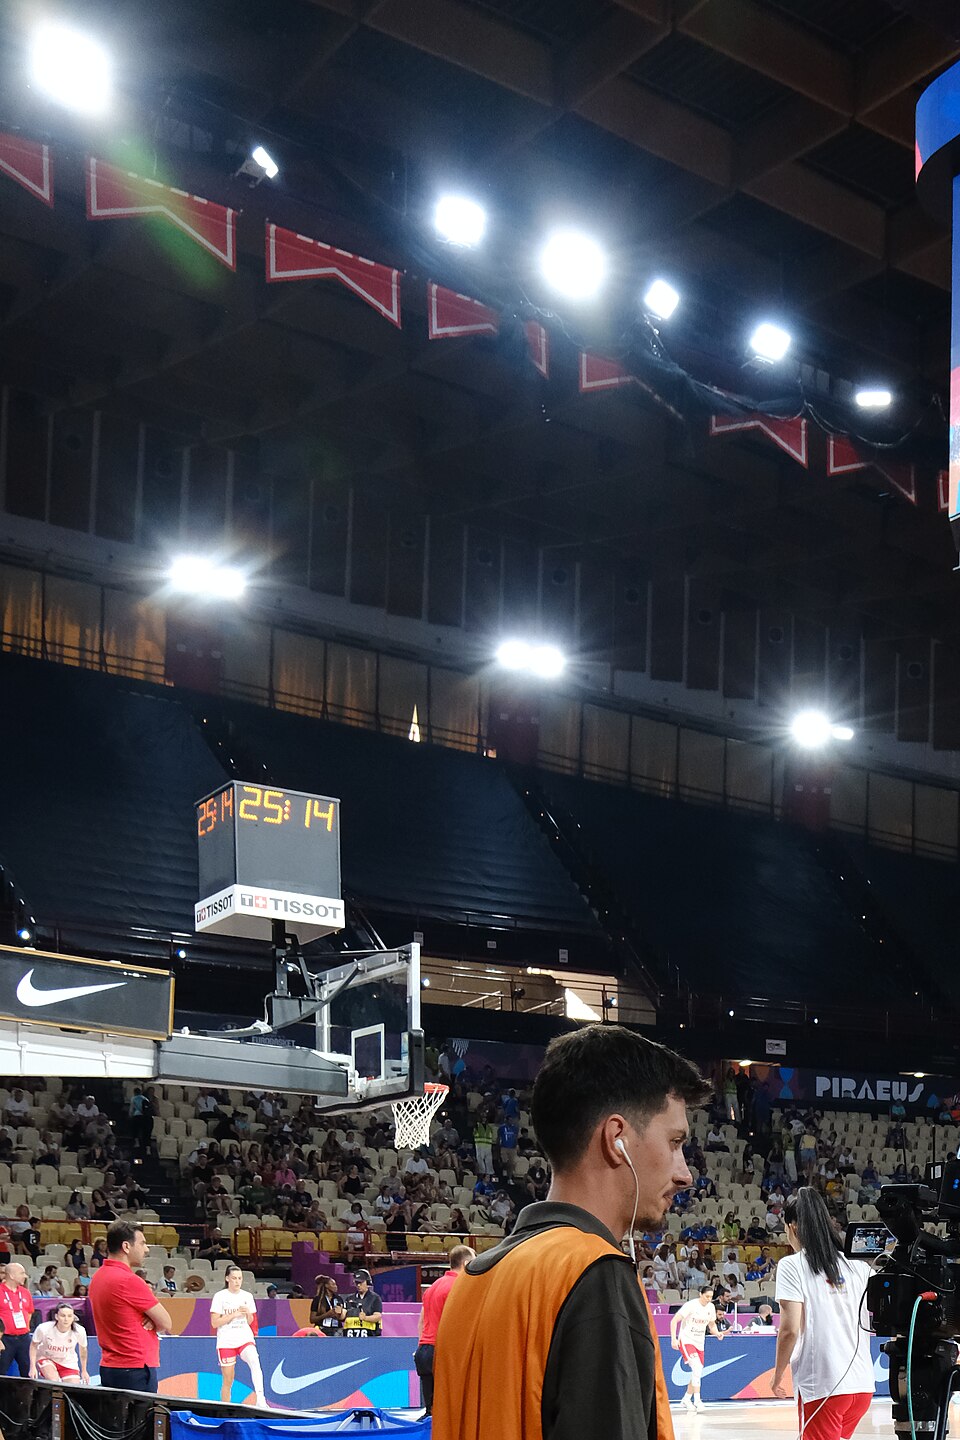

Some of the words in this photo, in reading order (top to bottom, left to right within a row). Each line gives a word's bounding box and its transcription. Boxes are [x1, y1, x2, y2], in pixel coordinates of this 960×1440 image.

[207, 894, 233, 918] TISSOT
[270, 898, 341, 919] TISSOT
[816, 1076, 924, 1102] PIRAEUS
